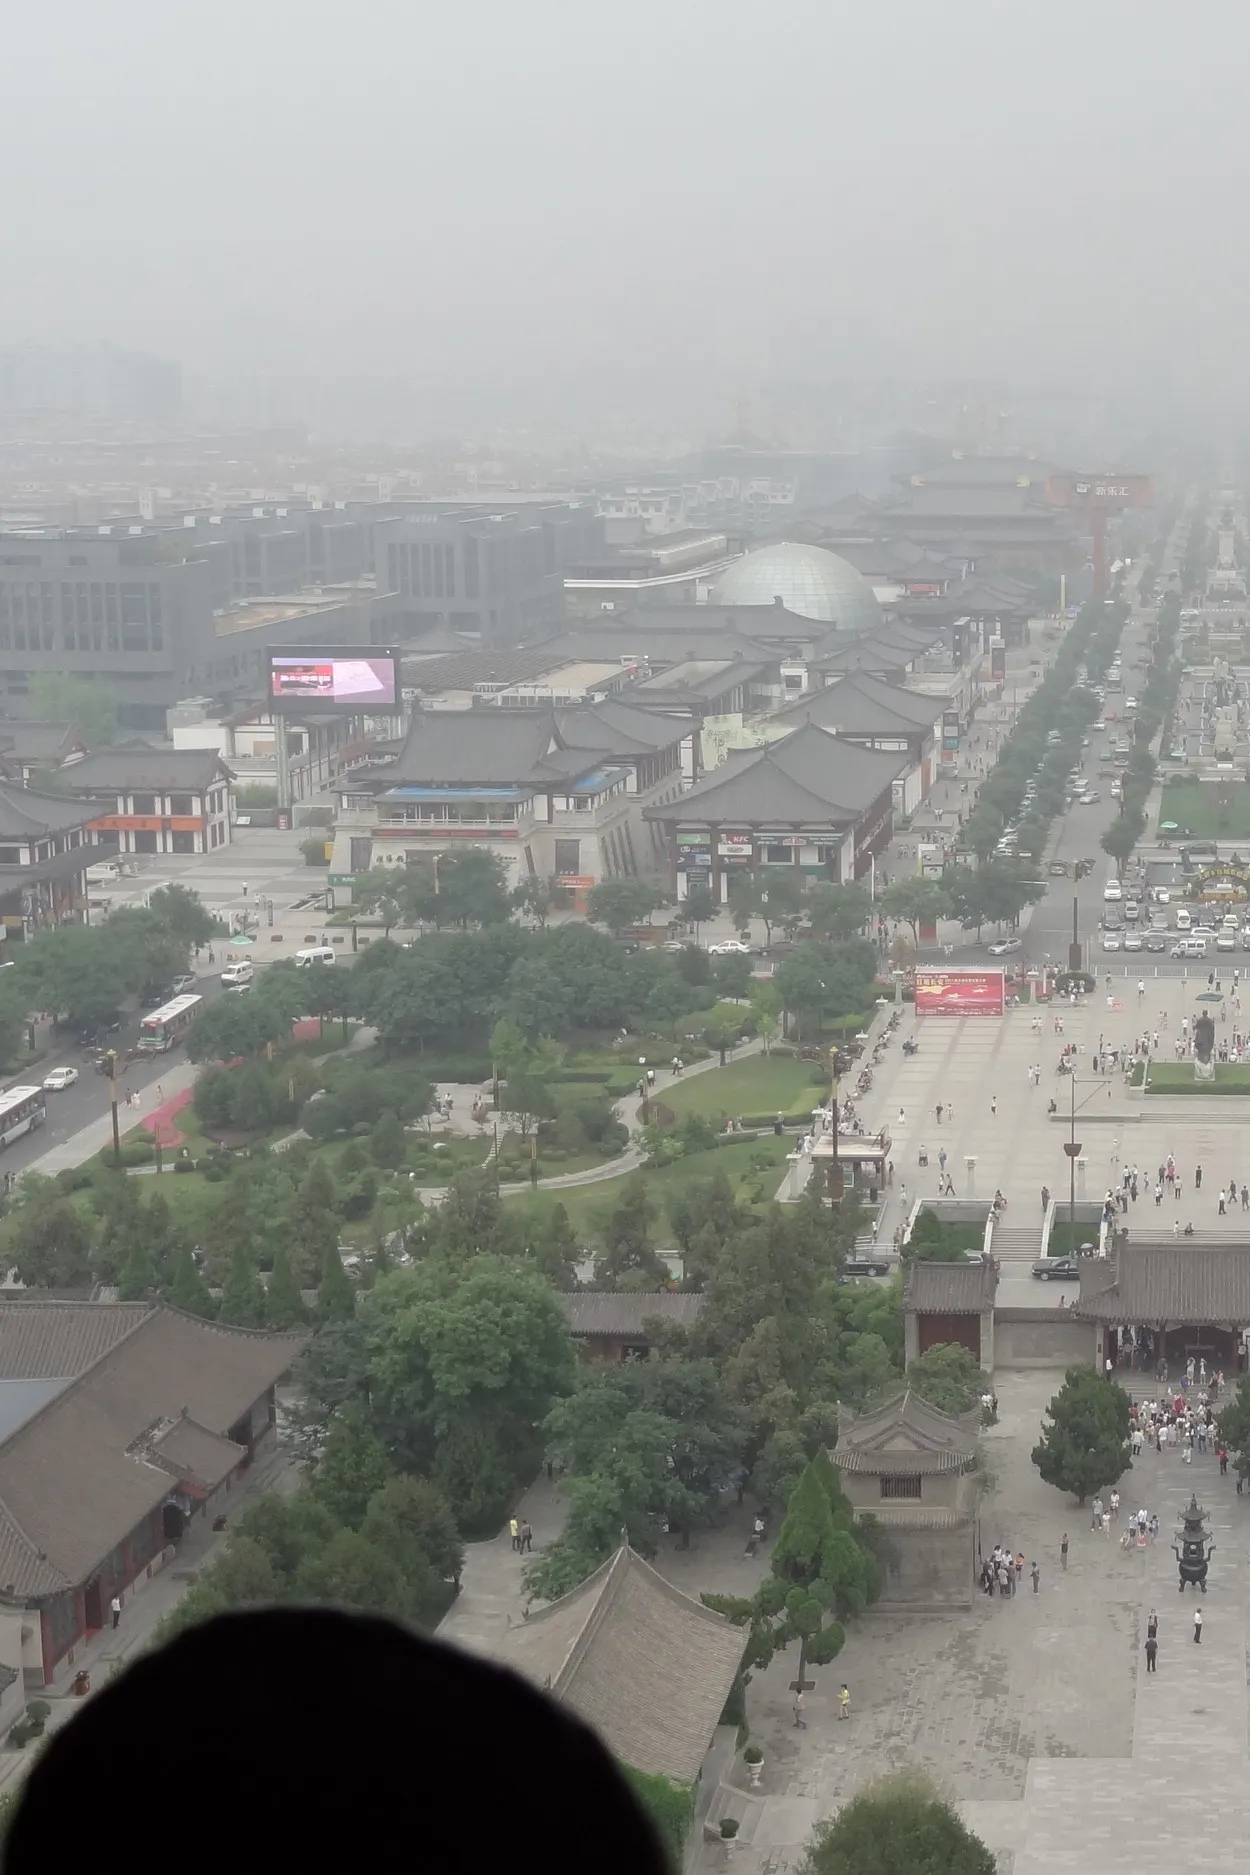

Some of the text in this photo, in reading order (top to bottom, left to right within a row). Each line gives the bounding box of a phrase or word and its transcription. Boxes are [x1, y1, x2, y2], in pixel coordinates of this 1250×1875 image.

[1096, 486, 1129, 496] 新乐汇
[733, 835, 750, 843] KFC
